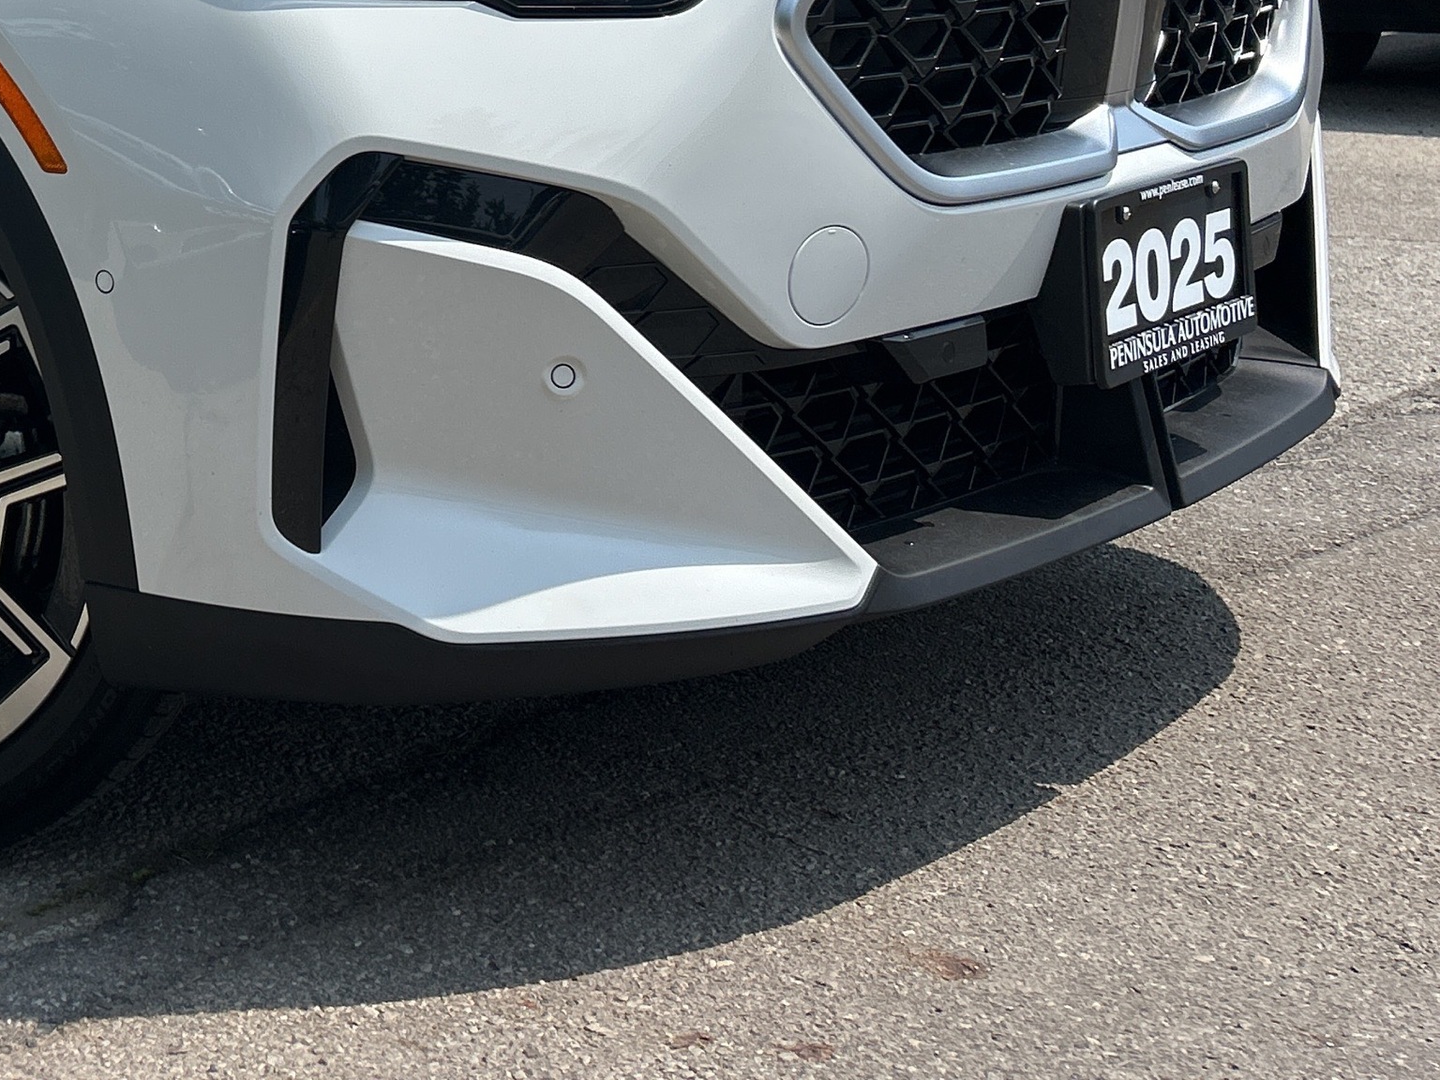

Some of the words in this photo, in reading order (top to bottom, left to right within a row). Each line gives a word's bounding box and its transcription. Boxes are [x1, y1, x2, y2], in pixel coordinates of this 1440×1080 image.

[1102, 208, 1236, 336] 2025
[1109, 324, 1177, 370] PENINSULA
[1178, 296, 1255, 343] AUTOMOTIVE
[1143, 353, 1169, 373] SALES
[1170, 346, 1188, 362] AND
[1190, 331, 1226, 354] LEASING
